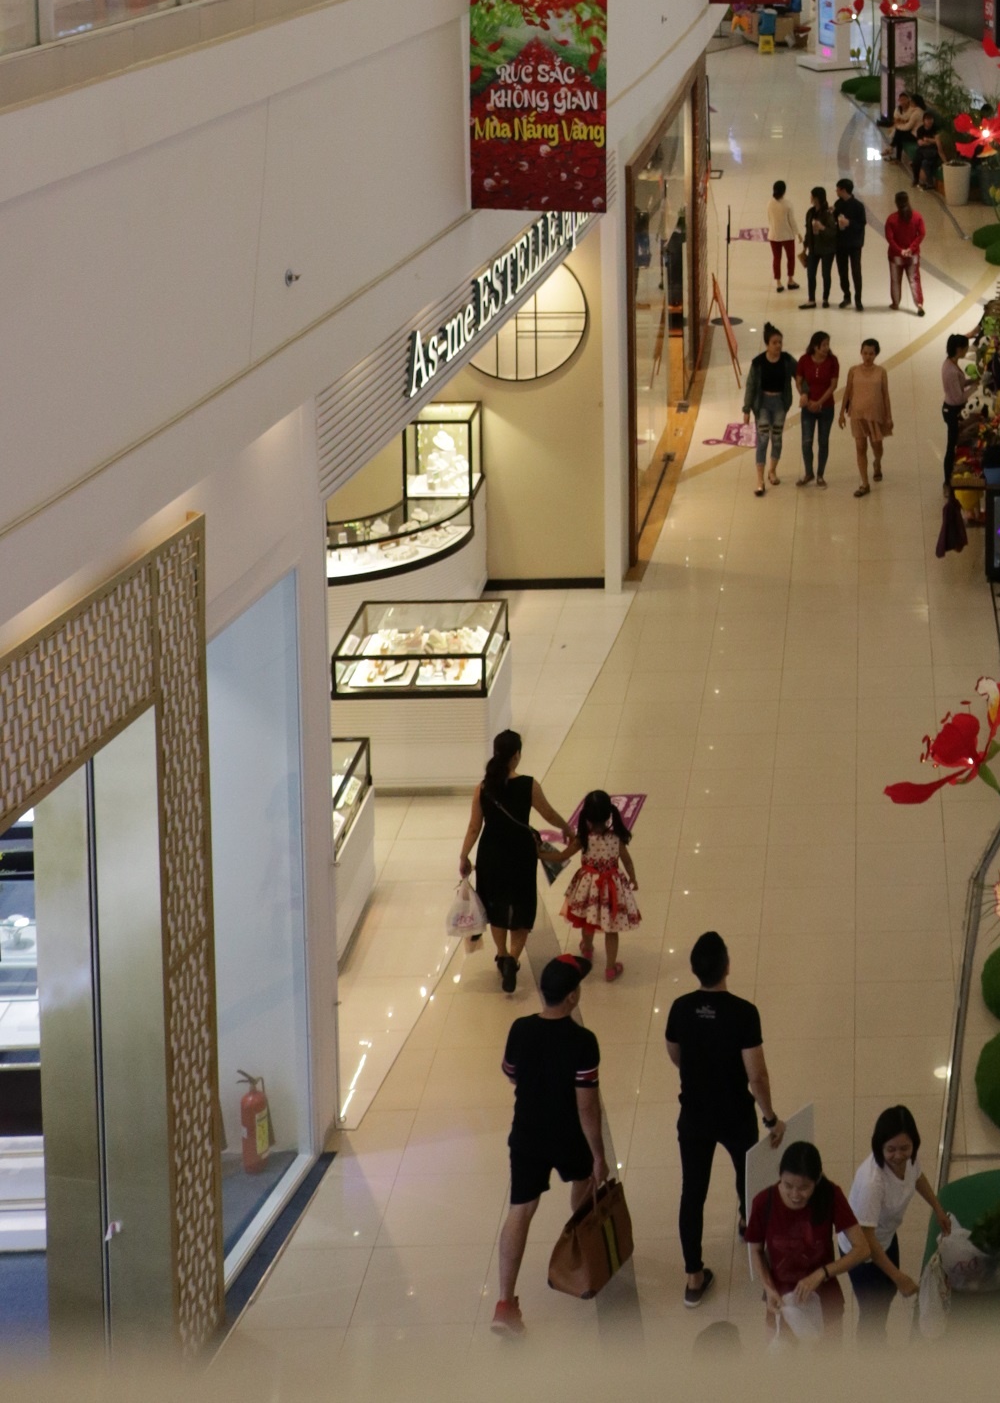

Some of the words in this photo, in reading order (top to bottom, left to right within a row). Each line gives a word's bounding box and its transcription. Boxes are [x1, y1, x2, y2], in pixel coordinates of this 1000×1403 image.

[553, 87, 598, 115] GIAN
[410, 331, 474, 397] As-me
[478, 211, 558, 331] ESTELLE
